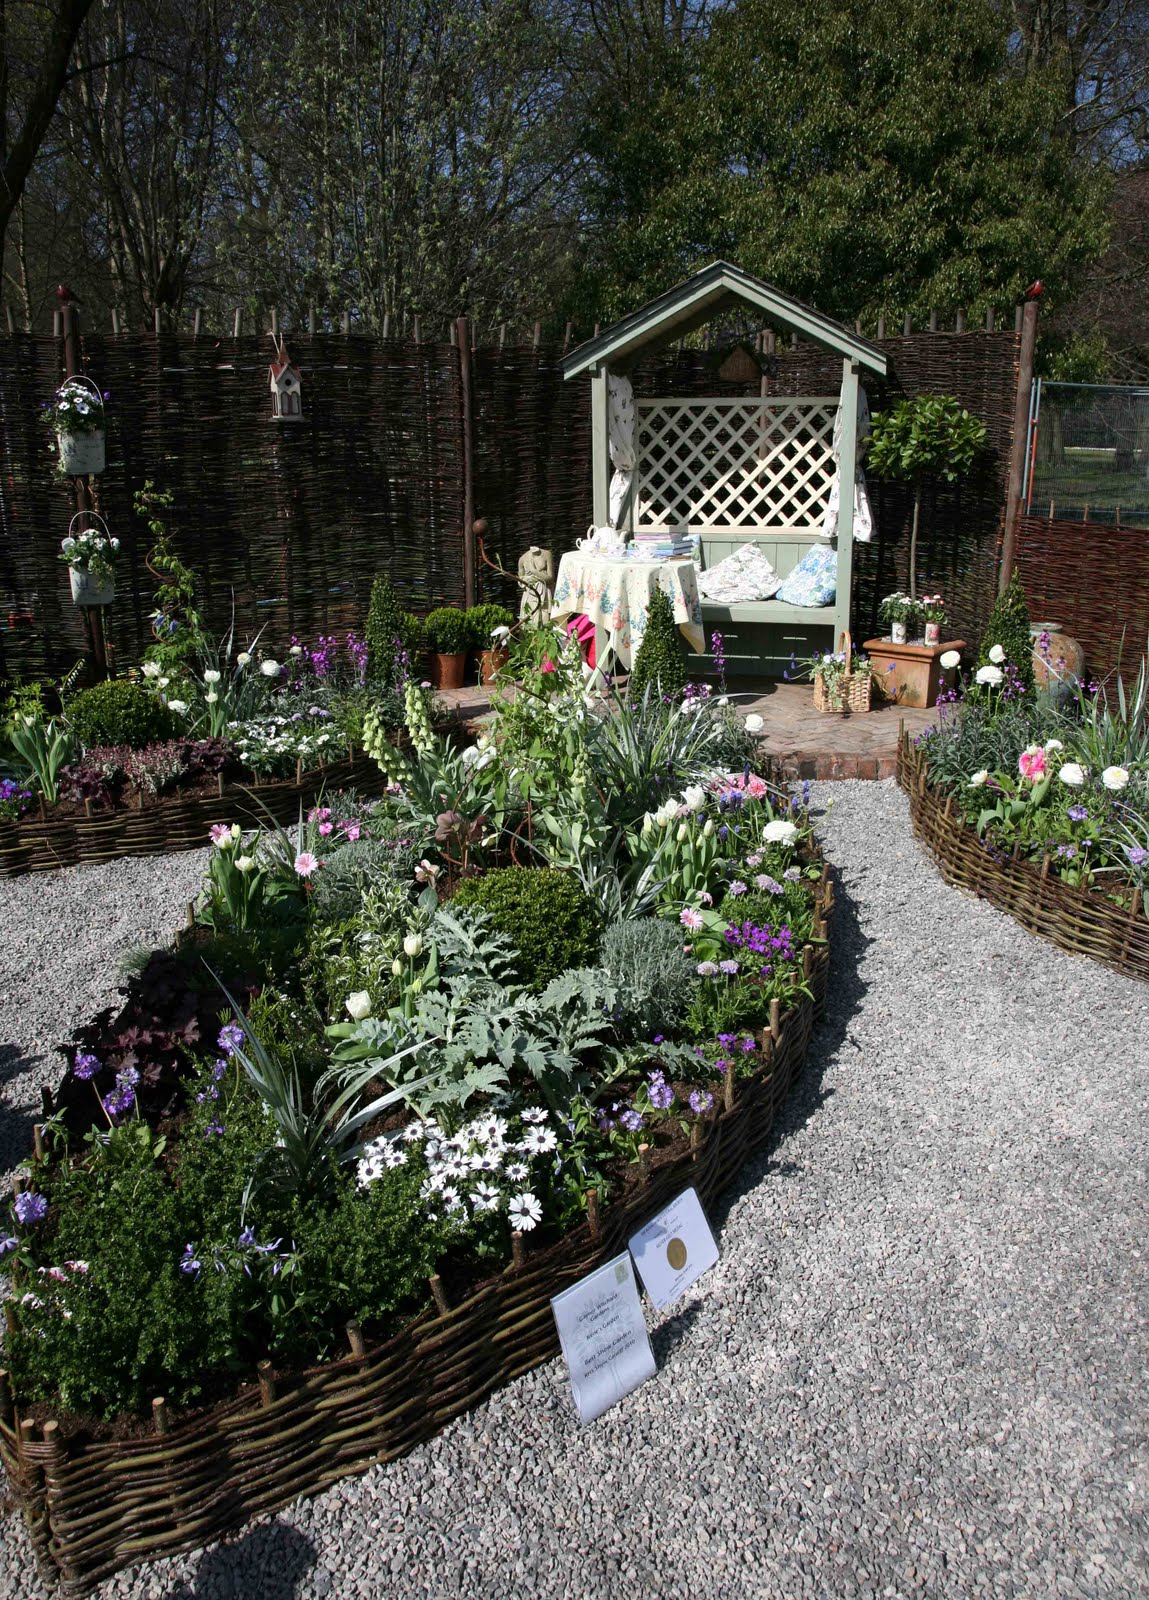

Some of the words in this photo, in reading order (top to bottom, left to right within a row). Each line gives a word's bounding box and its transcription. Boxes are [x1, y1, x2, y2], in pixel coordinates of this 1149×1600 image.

[590, 1307, 609, 1322] Gardens
[602, 1314, 620, 1329] Garden
[584, 1354, 597, 1366] Best
[597, 1344, 612, 1357] Show
[612, 1330, 632, 1346] Garden
[594, 1358, 608, 1371] Show
